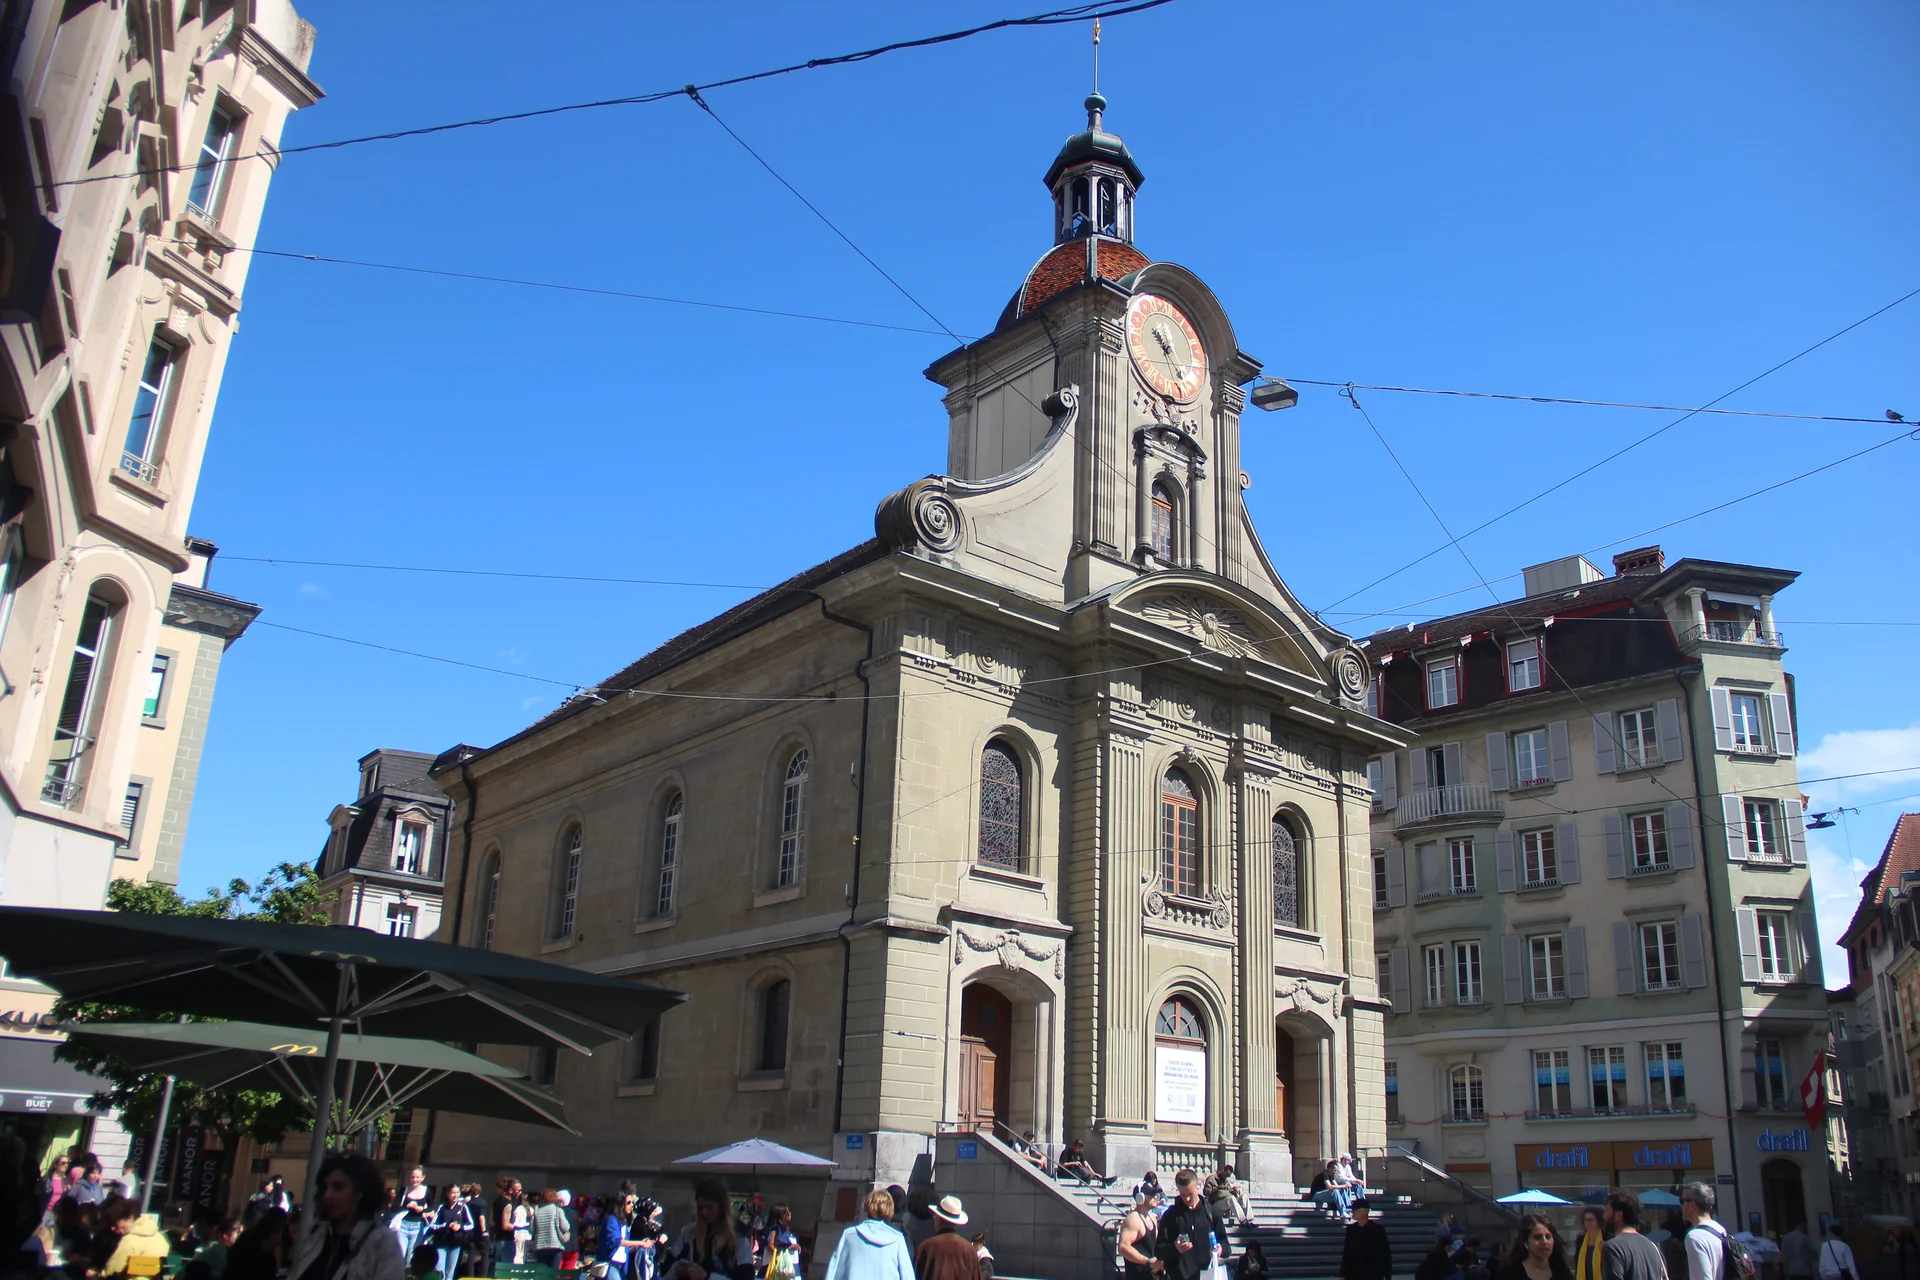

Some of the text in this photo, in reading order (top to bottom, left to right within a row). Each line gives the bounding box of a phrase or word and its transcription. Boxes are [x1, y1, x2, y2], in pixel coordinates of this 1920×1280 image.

[25, 1099, 53, 1108] BUET
[1757, 1128, 1810, 1151] drafil
[181, 1136, 198, 1196] MANOR
[1535, 1146, 1589, 1169] drafil
[1633, 1144, 1691, 1167] drafil
[197, 1159, 218, 1209] ANOR
